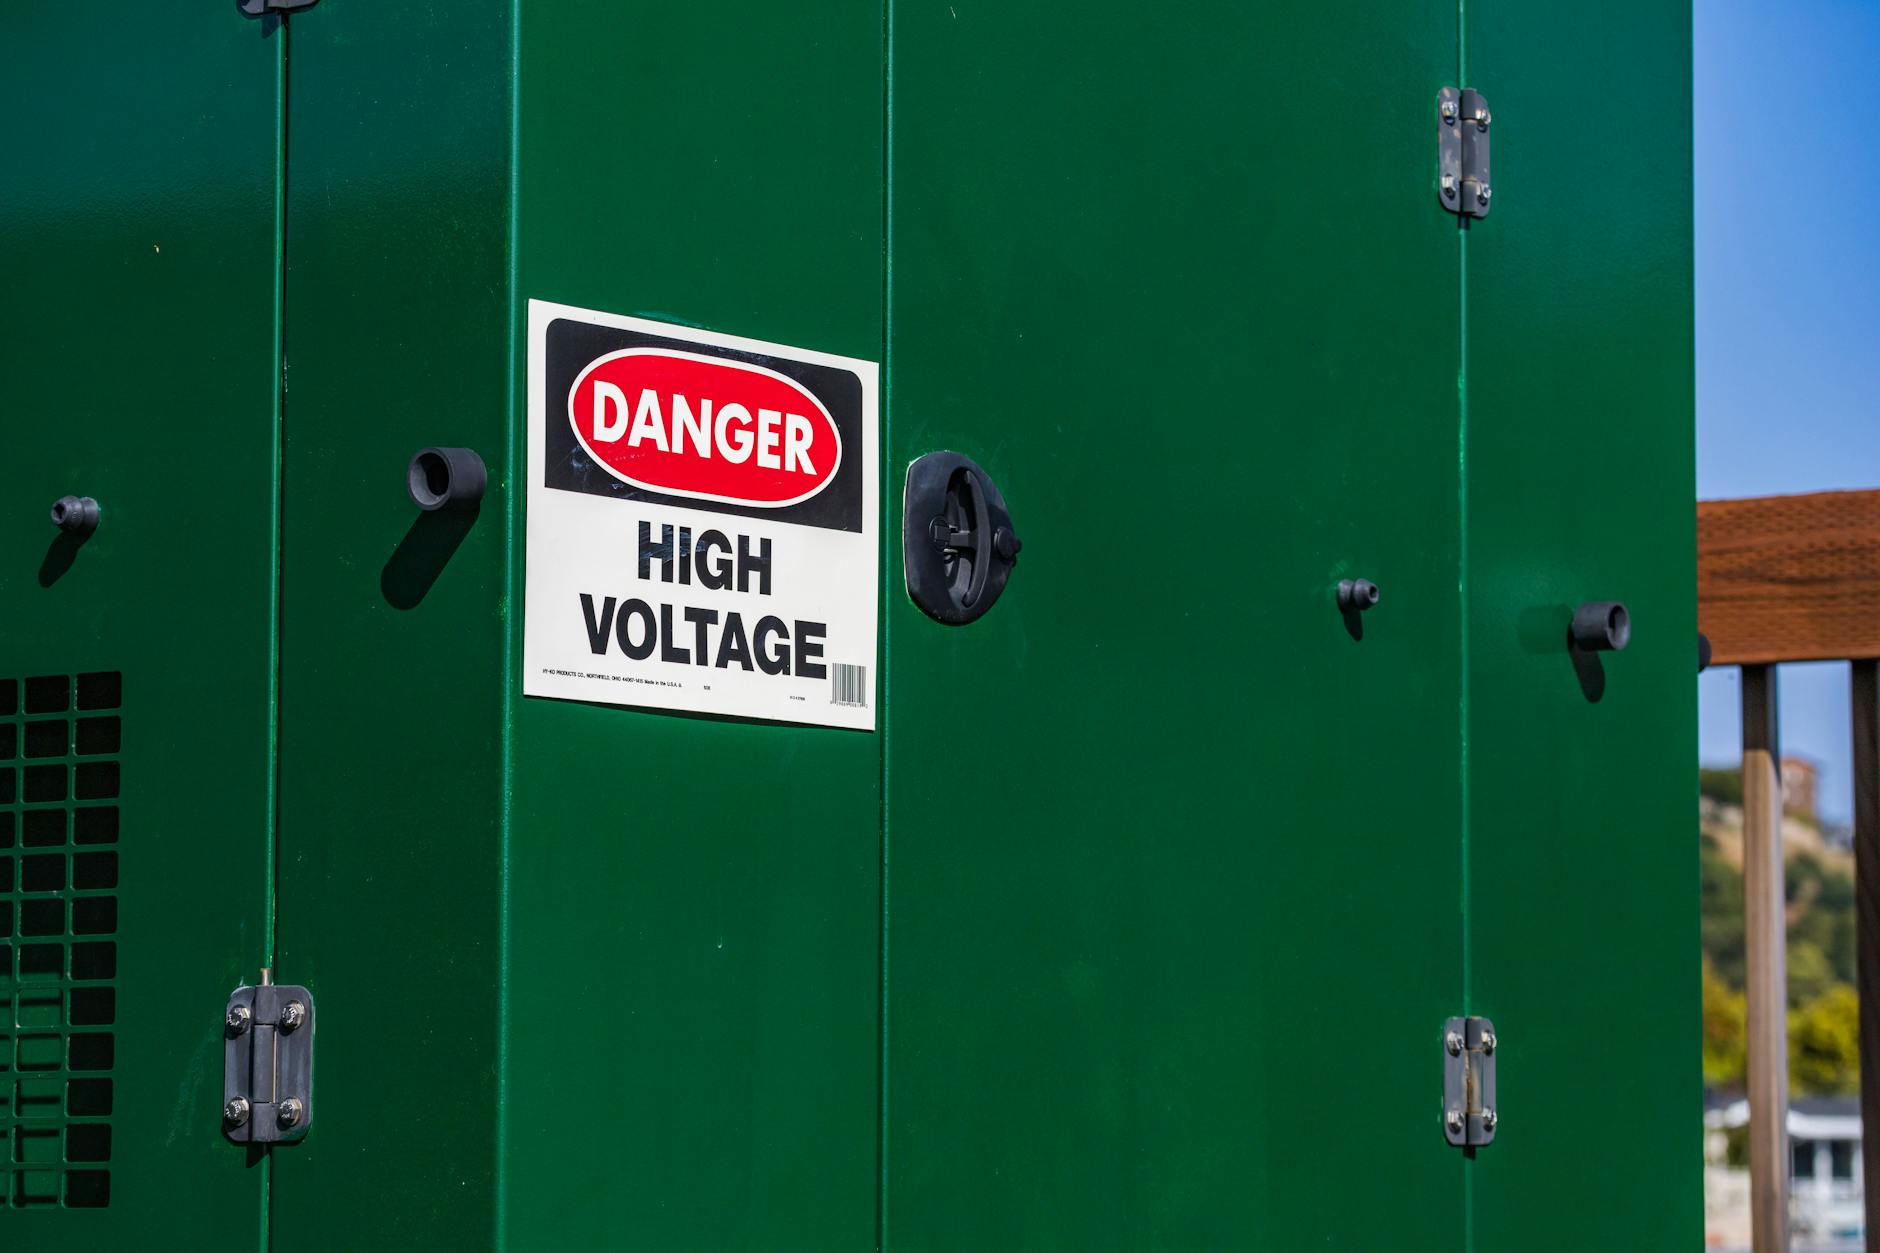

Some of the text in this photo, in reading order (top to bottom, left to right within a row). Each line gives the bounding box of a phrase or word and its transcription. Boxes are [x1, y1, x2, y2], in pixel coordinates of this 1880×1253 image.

[593, 379, 817, 476] DANGER
[637, 520, 772, 596] HIGH
[556, 669, 577, 677] PRODUCTS
[579, 593, 827, 680] VOLTAGE
